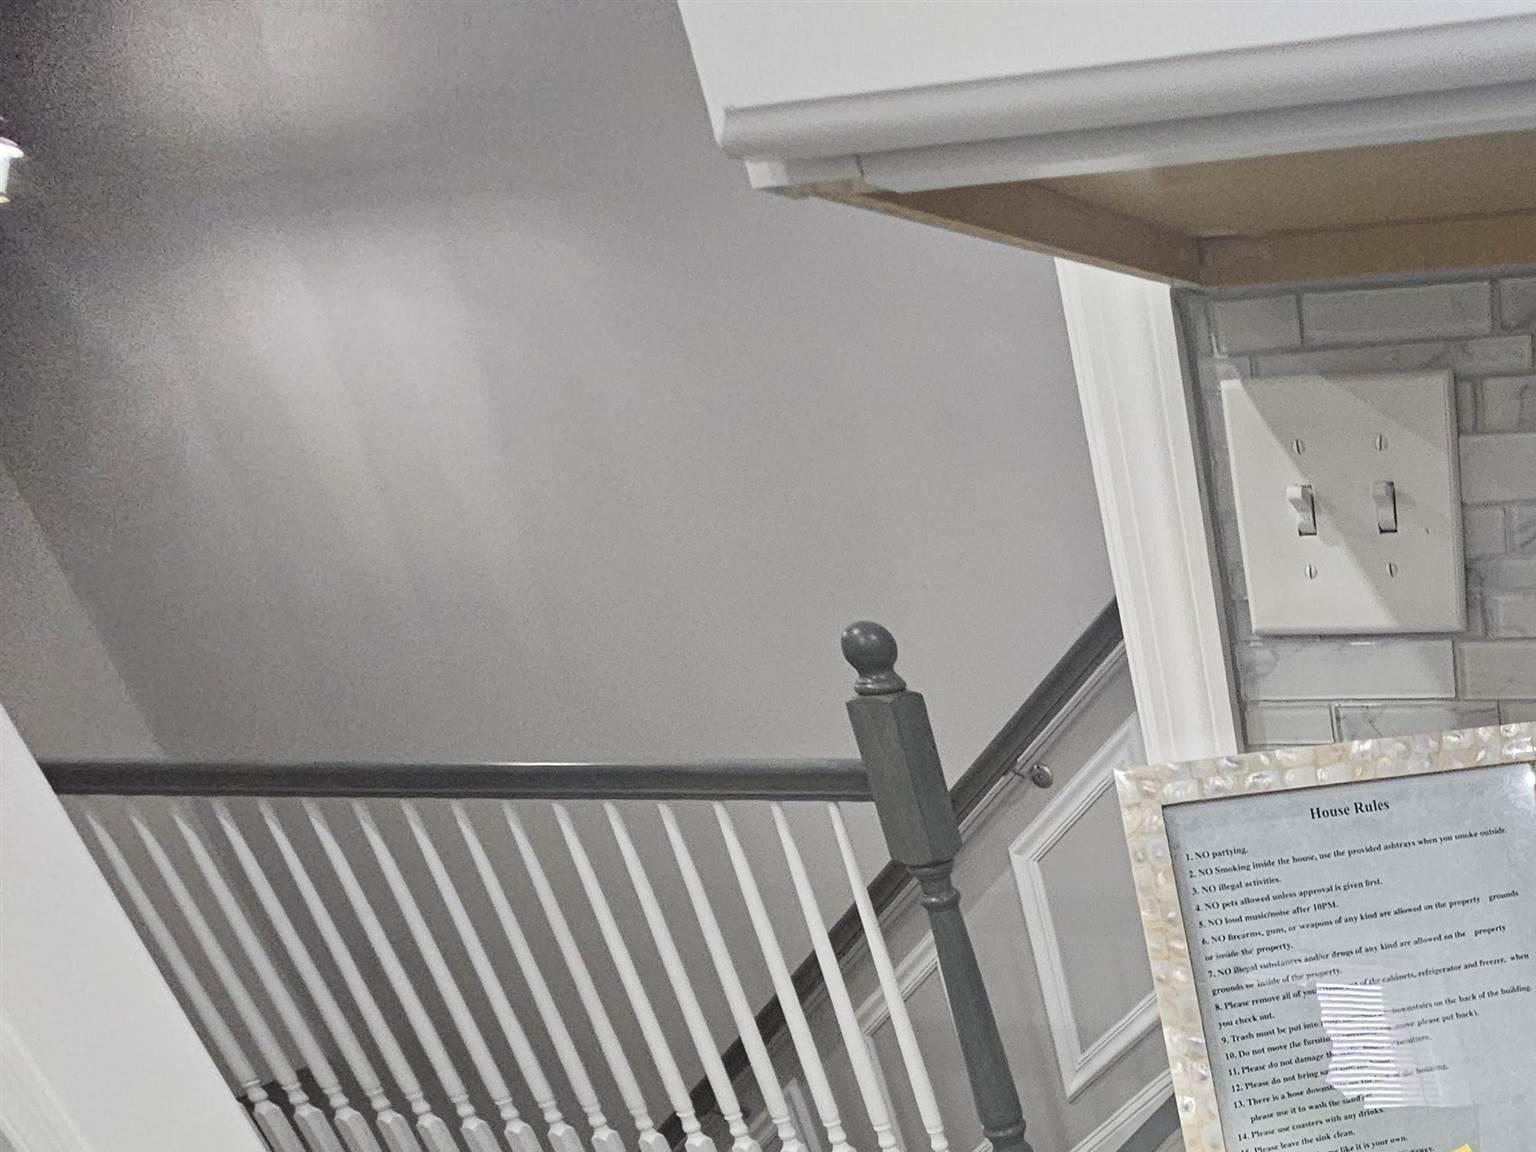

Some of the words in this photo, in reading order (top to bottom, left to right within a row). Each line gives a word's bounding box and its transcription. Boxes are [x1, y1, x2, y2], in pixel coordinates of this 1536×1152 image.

[1310, 806, 1350, 820] House
[1354, 800, 1390, 814] Rules
[1195, 851, 1210, 860] NO
[1198, 868, 1213, 878] NO
[1215, 864, 1251, 875] Smoking
[1253, 860, 1276, 870] inside
[1278, 858, 1290, 866] the
[1333, 850, 1346, 858] the
[1348, 844, 1381, 858] provided
[1384, 841, 1416, 851] ashtrays
[1418, 837, 1437, 846] when
[1440, 835, 1452, 845] you
[1201, 884, 1216, 893] NO
[1218, 880, 1243, 891] illegal
[1205, 901, 1219, 910] NO
[1240, 893, 1270, 905] allowed
[1299, 884, 1333, 898] approval
[1334, 883, 1341, 891] is
[1343, 881, 1363, 892] given
[1208, 917, 1223, 926] NO
[1225, 914, 1243, 924] loud
[1292, 905, 1310, 913] after
[1211, 933, 1226, 943] NO
[1335, 915, 1342, 924] of
[1344, 915, 1358, 923] any
[1360, 910, 1377, 920] kind
[1394, 903, 1422, 915] allowed
[1435, 900, 1446, 908] the
[1449, 895, 1480, 908] property
[1217, 967, 1231, 976] NO
[1331, 949, 1354, 958] drugs
[1355, 946, 1362, 954] of
[1364, 945, 1378, 953] any
[1380, 940, 1398, 950] kind
[1414, 933, 1442, 945] allowed
[1454, 930, 1465, 938] the
[1474, 923, 1506, 937] property
[1224, 1000, 1250, 1009] Please
[1252, 994, 1280, 1005] remove
[1282, 991, 1291, 1000] all
[1293, 989, 1301, 998] of
[1464, 959, 1478, 969] and
[1510, 952, 1529, 961] when
[1218, 1019, 1233, 1029] you
[1235, 1013, 1258, 1024] check
[1231, 1031, 1254, 1043] Trash
[1256, 1028, 1275, 1038] must
[1277, 1027, 1286, 1035] be
[1288, 1023, 1301, 1035] put
[1445, 996, 1457, 1005] the
[1459, 992, 1476, 1003] back
[1478, 991, 1486, 999] of
[1487, 989, 1499, 998] the
[1239, 1049, 1249, 1058] Do
[1251, 1046, 1264, 1055] not
[1266, 1044, 1287, 1053] move
[1289, 1040, 1301, 1049] the
[1442, 1013, 1454, 1024] put
[1241, 1063, 1266, 1073] Please
[1268, 1060, 1278, 1068] do
[1280, 1057, 1293, 1066] not
[1295, 1053, 1324, 1064] damage
[1271, 1076, 1281, 1084] do
[1283, 1072, 1295, 1082] not
[1298, 1069, 1319, 1079] bring
[1248, 1096, 1269, 1106] There
[1251, 1111, 1273, 1123] please
[1290, 1105, 1296, 1114] it
[1298, 1104, 1306, 1112] to
[1251, 1128, 1275, 1138] Please
[1325, 1113, 1342, 1124] with
[1344, 1112, 1357, 1121] any
[1281, 1140, 1299, 1149] leave
[1302, 1136, 1313, 1145] the
[1316, 1132, 1331, 1142] sink
[1356, 1143, 1361, 1151] it
[1363, 1142, 1369, 1150] is
[1372, 1139, 1388, 1150] your
